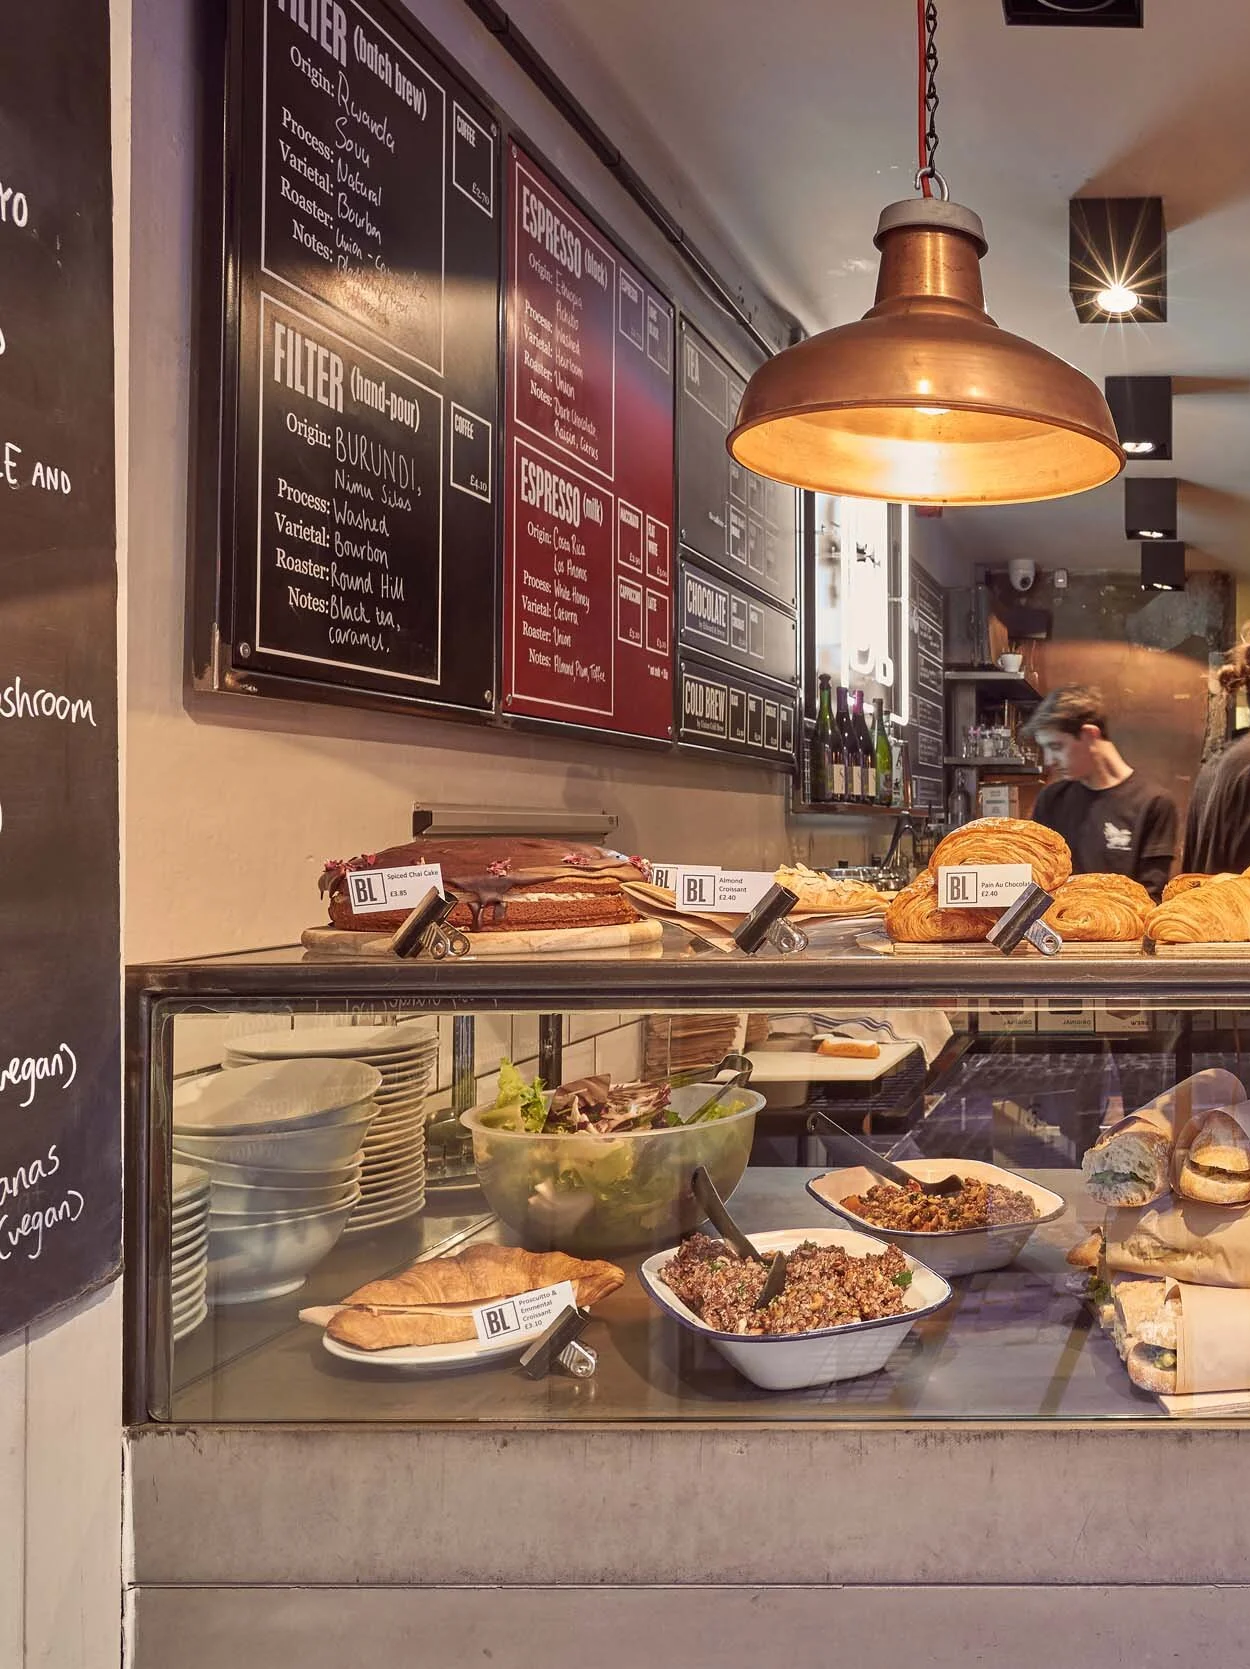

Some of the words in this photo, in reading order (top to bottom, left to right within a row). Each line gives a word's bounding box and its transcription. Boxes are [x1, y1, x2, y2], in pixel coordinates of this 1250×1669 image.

[353, 25, 392, 88] (batch
[395, 63, 427, 121] brew)
[290, 46, 335, 97] Origin:
[338, 70, 395, 153] Rwanda
[456, 115, 476, 148] COFFEE
[281, 106, 334, 163] Process:
[337, 157, 382, 206] Natural
[279, 138, 334, 196] Varietal:
[338, 193, 382, 245] Bourbon
[280, 176, 333, 229] Roaster:
[336, 228, 363, 260] Union
[523, 185, 582, 279] ESPRESSO
[292, 219, 333, 262] Notes:
[274, 321, 344, 413] FILTER
[350, 365, 420, 433] (hand-pour)
[524, 350, 553, 382] Roaster:
[530, 379, 553, 407] Notes:
[286, 412, 331, 448] Origin:
[454, 414, 475, 440] COFFEE
[32, 462, 72, 494] AND
[521, 456, 580, 528] ESPRESSO
[277, 477, 330, 514] Process:
[332, 498, 390, 537] Washed
[275, 511, 330, 548] Varietal:
[335, 531, 389, 569] Bourbon
[527, 521, 552, 544] Origin:
[275, 548, 330, 581] Roaster:
[331, 561, 374, 594] Round
[381, 573, 404, 601] Hill
[523, 570, 552, 593] Process:
[287, 585, 329, 614] Notes:
[330, 594, 371, 624] Black
[375, 606, 401, 632] tea,
[522, 595, 551, 617] Varietal:
[687, 578, 727, 628] CHOCOLATE
[328, 626, 390, 653] caramel.
[522, 621, 551, 642] Roaster:
[529, 647, 551, 667] Notes:
[0, 676, 97, 727] shroom
[684, 680, 704, 717] COLD
[705, 686, 726, 724] BREW
[353, 878, 377, 903] BL
[387, 872, 408, 880] Spiced
[655, 870, 669, 888] BL
[687, 879, 706, 902] BL
[950, 876, 968, 900] BL
[486, 1308, 510, 1335] BL
[520, 1300, 553, 1314] Emmental
[522, 1309, 552, 1322] Croissant
[524, 1320, 543, 1330] £3.10
